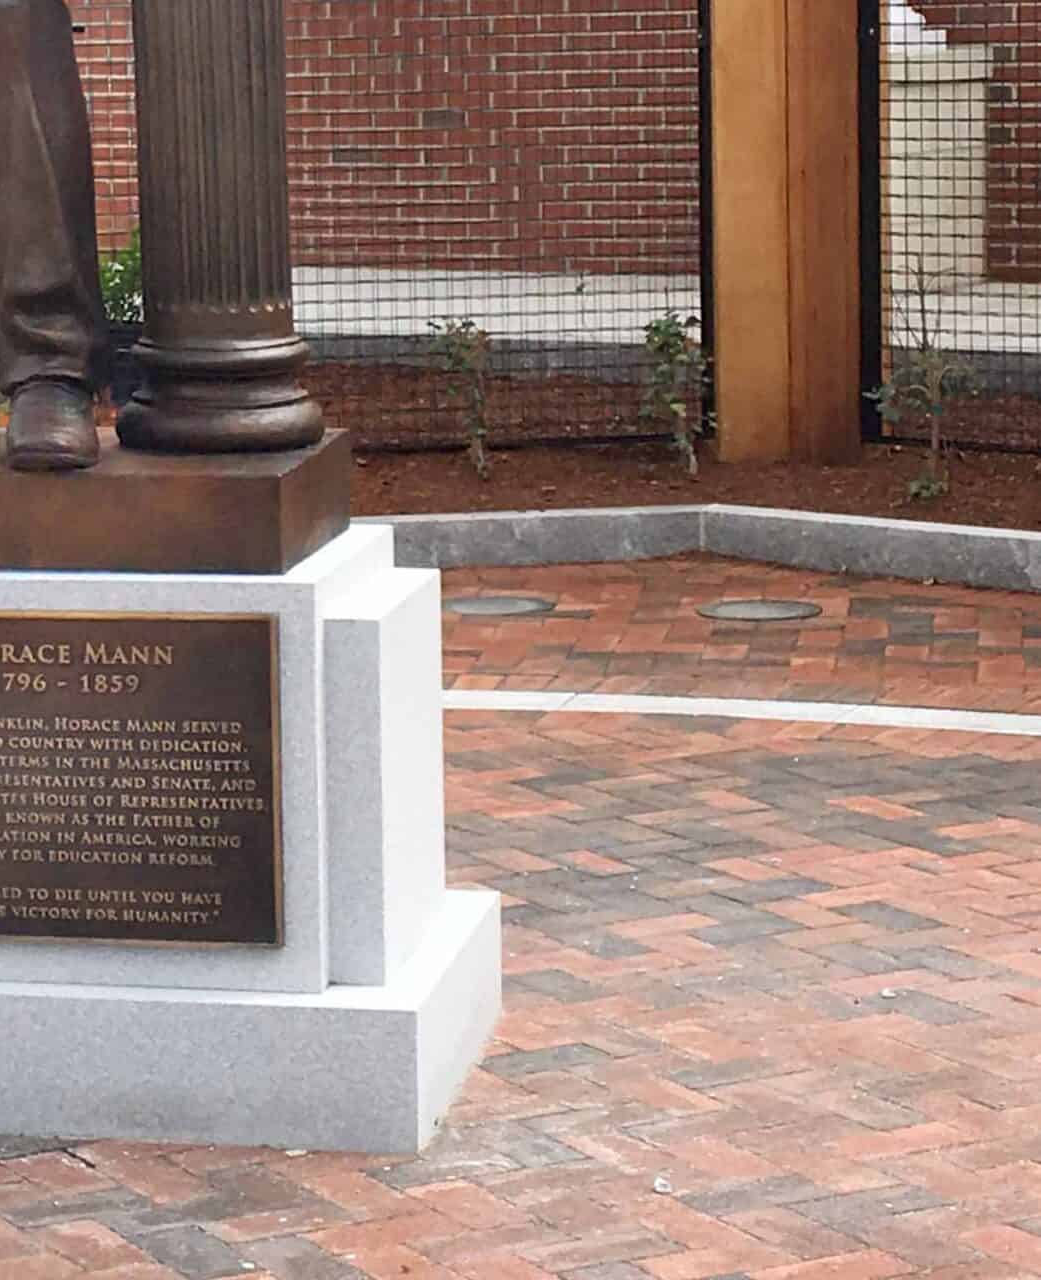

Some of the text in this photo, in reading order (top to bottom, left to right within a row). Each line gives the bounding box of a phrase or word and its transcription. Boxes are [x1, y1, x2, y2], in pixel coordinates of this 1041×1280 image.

[84, 642, 174, 665] MANN
[80, 674, 139, 693] 1859
[54, 717, 119, 732] HORACE
[127, 719, 175, 733] MANN
[182, 720, 242, 734] SERVED
[8, 737, 84, 750] COUNTRY
[90, 738, 133, 751] WITH
[140, 739, 248, 753] DEDICATION.
[56, 757, 73, 768] IN
[80, 757, 108, 769] THE
[117, 757, 250, 772] MASSACHUSETTS
[111, 777, 146, 789] AND
[151, 776, 216, 792] SENATE,
[221, 778, 256, 792] AND
[33, 792, 87, 806] HOUSE
[93, 795, 113, 806] OF
[5, 812, 65, 825] KNOWN
[71, 814, 89, 825] AS
[94, 814, 126, 826] THE
[133, 814, 195, 828] FATHER
[199, 817, 221, 829] OF
[58, 831, 75, 843] IN
[163, 835, 242, 848] WORKING
[13, 849, 44, 862] FOR
[49, 850, 142, 865] EDUCATION
[28, 888, 49, 900] TO
[55, 889, 82, 901] DIE
[87, 889, 137, 902] UNTIL
[142, 891, 175, 904] YOU
[182, 892, 222, 905] HAVE
[12, 906, 80, 920] VICTORY
[86, 909, 117, 920] FOR
